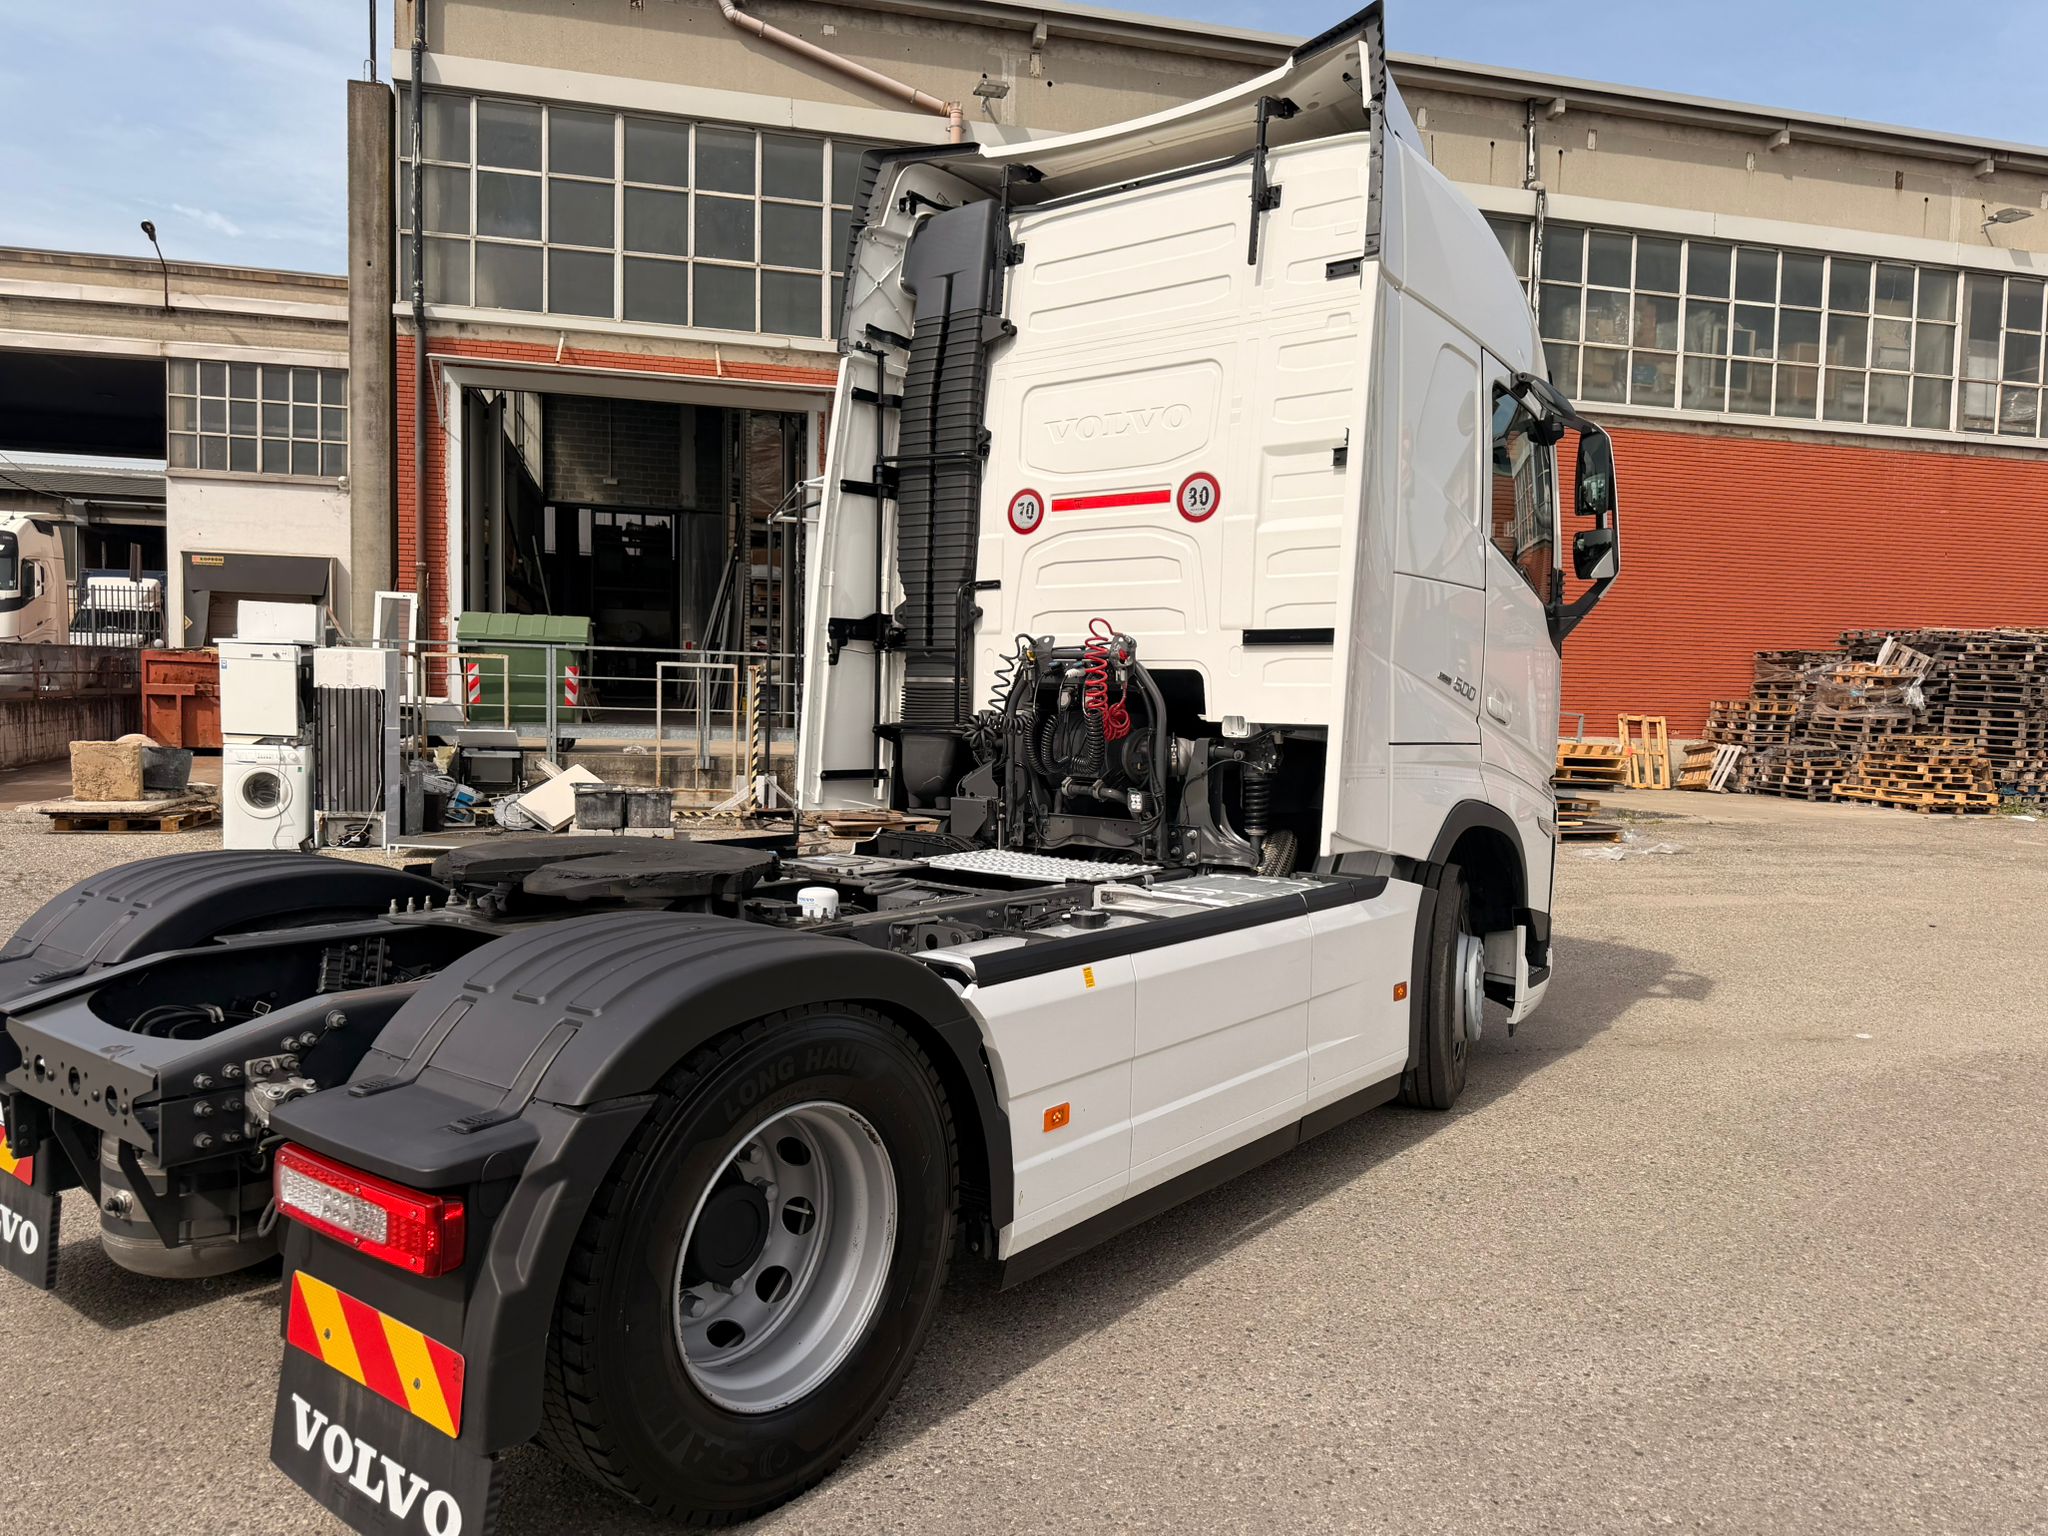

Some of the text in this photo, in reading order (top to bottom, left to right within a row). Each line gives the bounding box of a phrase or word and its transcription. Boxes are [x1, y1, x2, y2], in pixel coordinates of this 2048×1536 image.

[1044, 404, 1192, 444] VOLVO
[1189, 486, 1210, 507] 30
[1453, 676, 1476, 701] 500
[723, 1056, 794, 1121] LONG
[0, 1203, 39, 1255] VO
[292, 1392, 463, 1536] VOLVO
